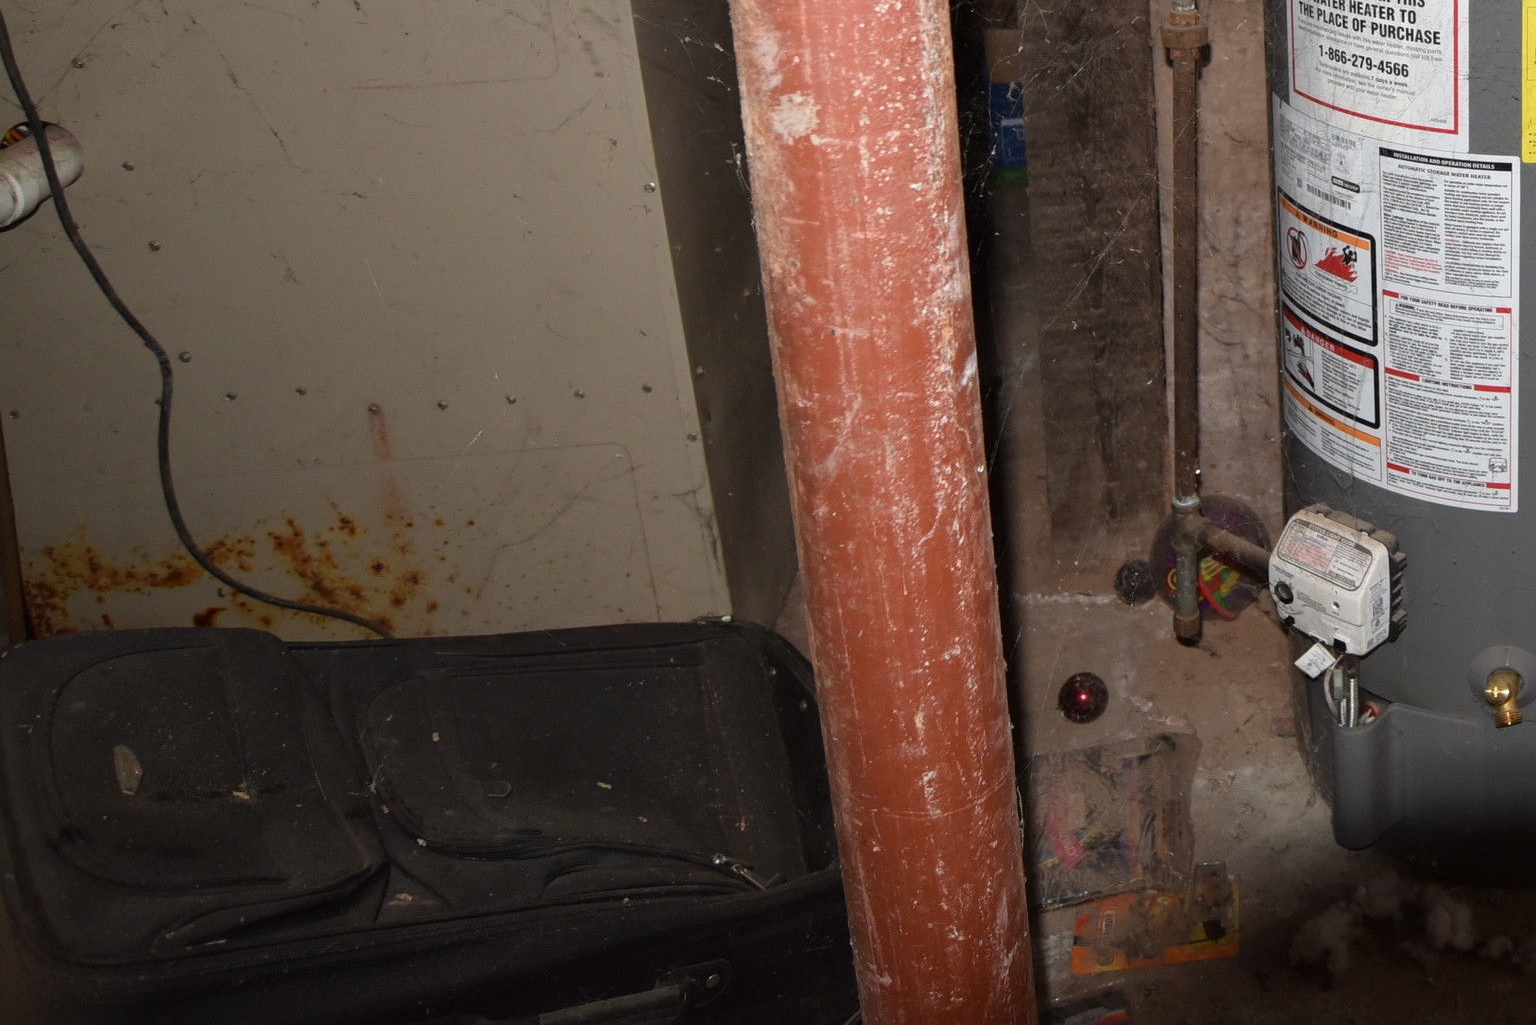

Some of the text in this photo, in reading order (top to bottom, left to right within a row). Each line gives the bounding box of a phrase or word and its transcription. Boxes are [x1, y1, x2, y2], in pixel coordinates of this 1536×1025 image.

[1349, 0, 1395, 22] HEATER
[1400, 9, 1417, 25] TO
[1299, 1, 1441, 46] THE PLACE OF PURCHASE
[1352, 33, 1362, 41] with
[1387, 40, 1404, 50] heater,
[1406, 44, 1426, 54] missing
[1428, 48, 1444, 56] parts,
[1366, 44, 1384, 54] general
[1385, 48, 1410, 58] questions
[1318, 44, 1410, 78] 1-866-279-4566
[1328, 78, 1347, 90] provided
[1356, 86, 1366, 94] your
[1376, 76, 1388, 85] days
[1376, 83, 1396, 92] owner's
[1396, 88, 1415, 96] manual
[1394, 152, 1428, 164] INSTALLATION
[1442, 160, 1472, 168] OPERATION
[1398, 164, 1426, 173] AUTOMATIC
[1303, 217, 1338, 238] WARNING
[1328, 290, 1342, 302] HAZARD
[1422, 299, 1436, 307] SAFETY
[1306, 330, 1335, 352] DANGER
[1442, 381, 1472, 390] INSTRUCTIONS
[1309, 523, 1356, 546] STATUS LIGHT CODE
